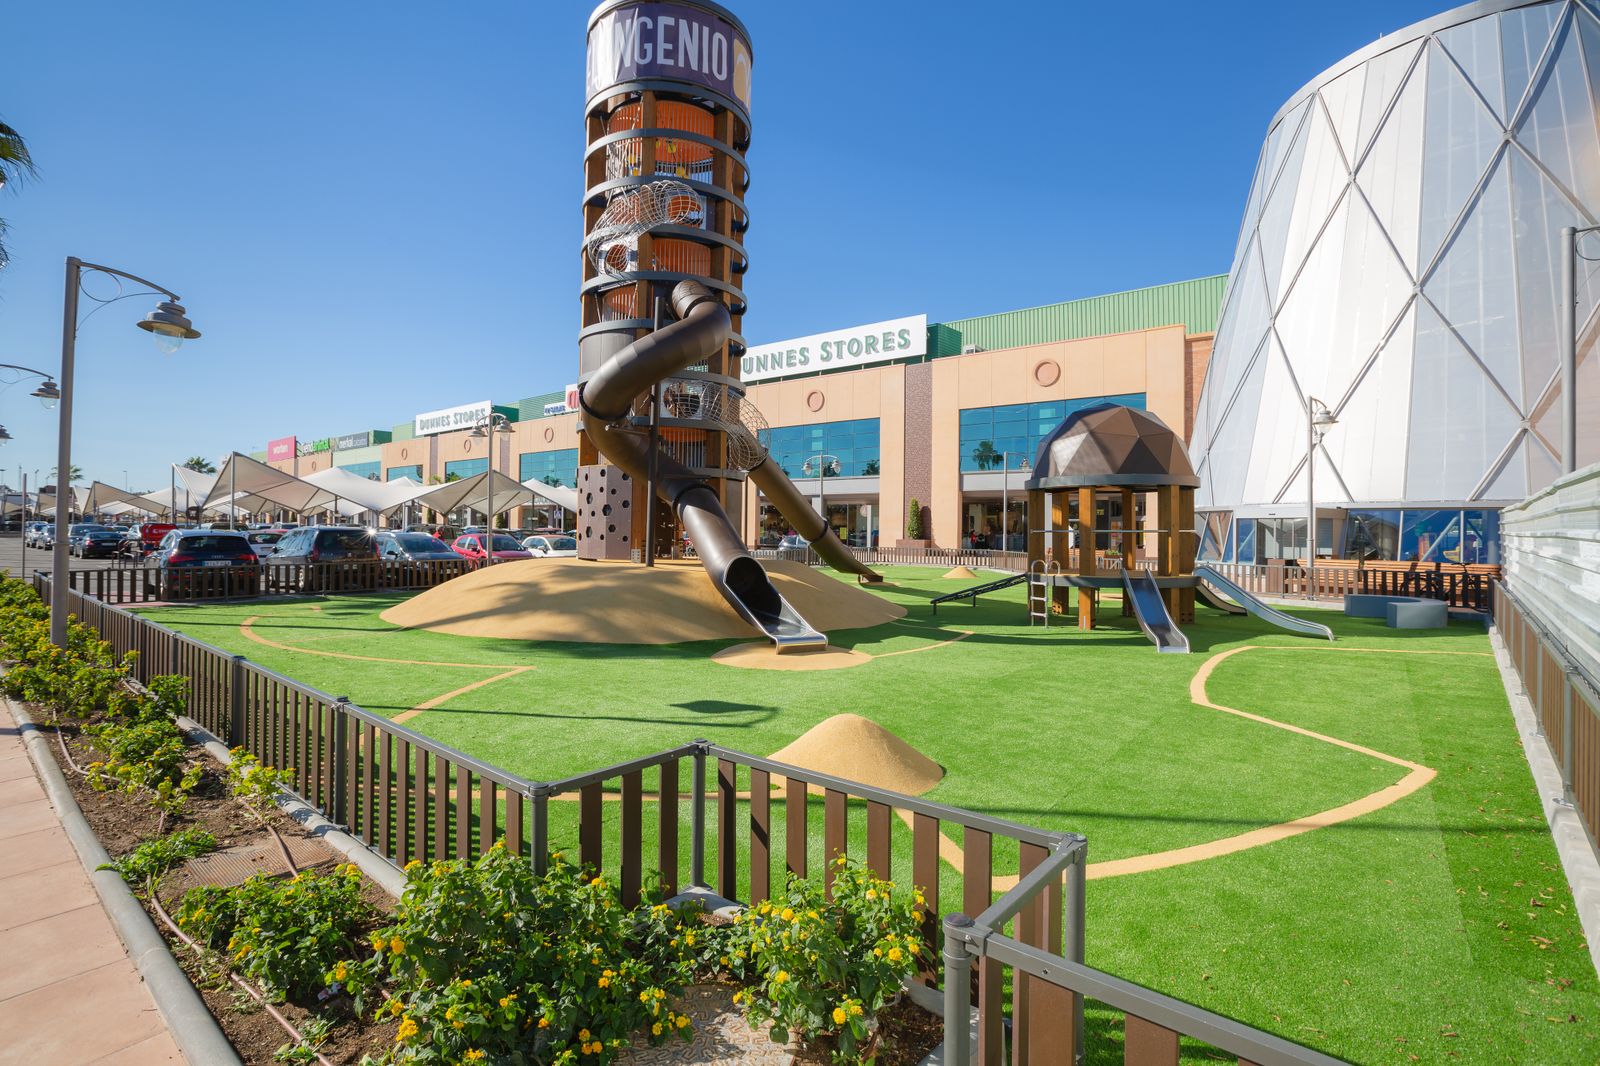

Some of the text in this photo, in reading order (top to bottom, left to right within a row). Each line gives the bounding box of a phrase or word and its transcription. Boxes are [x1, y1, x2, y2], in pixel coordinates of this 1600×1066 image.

[613, 15, 728, 82] NGENIO
[742, 328, 912, 375] UNNES STORES
[419, 408, 486, 431] DUNNES STORES
